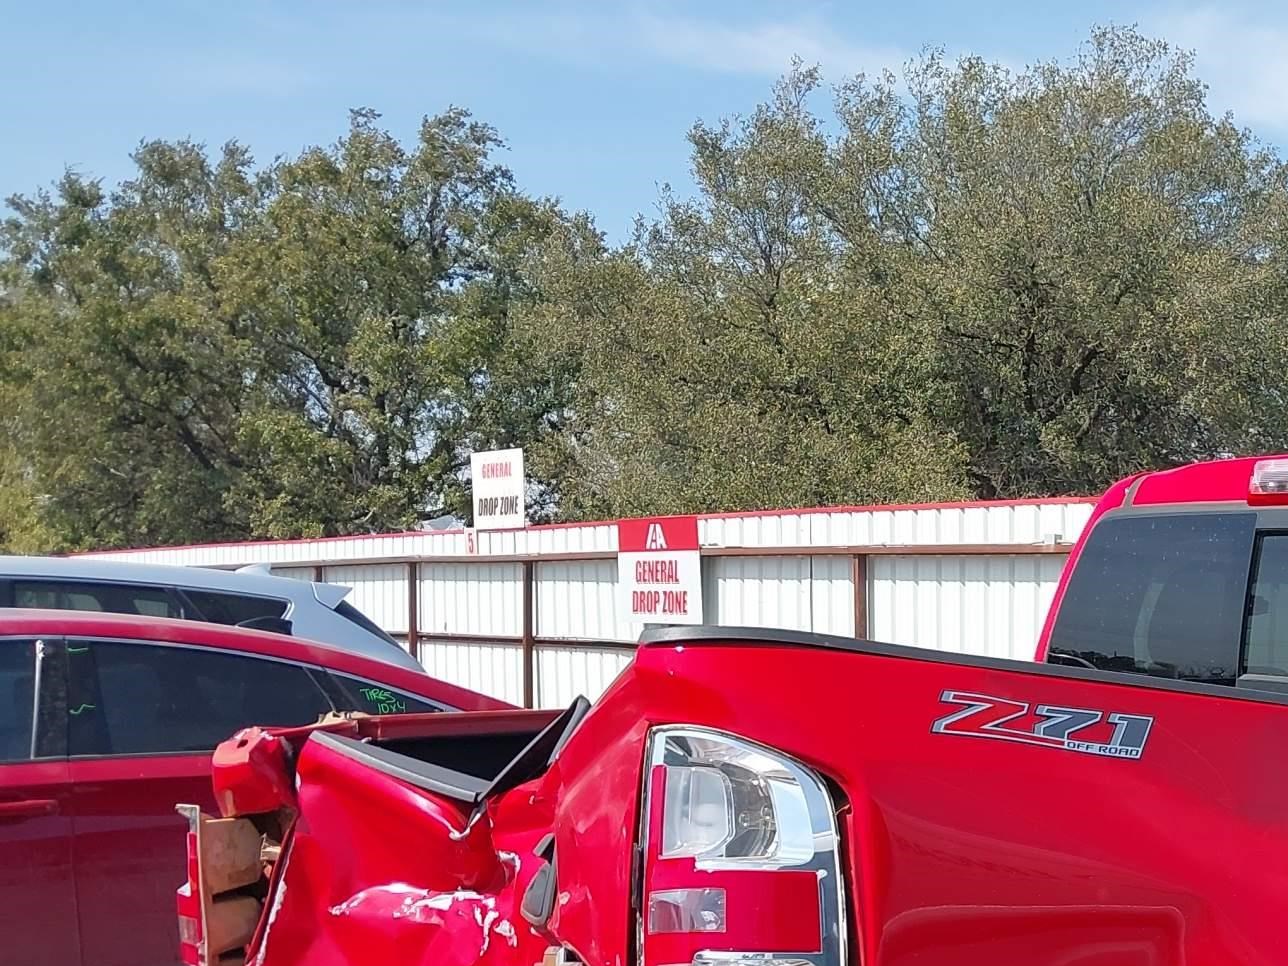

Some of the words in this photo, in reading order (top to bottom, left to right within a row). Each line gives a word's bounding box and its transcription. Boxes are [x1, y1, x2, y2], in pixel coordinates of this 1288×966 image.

[481, 461, 512, 479] GENERAL
[478, 497, 498, 516] DROP
[500, 495, 519, 515] ZONE
[467, 532, 474, 553] 5
[635, 560, 680, 584] GENERAL
[632, 591, 660, 614] DROP
[662, 591, 688, 615] ZONE
[931, 690, 1154, 753] Z71
[1066, 740, 1096, 753] OFF
[1098, 745, 1140, 757] ROAD
